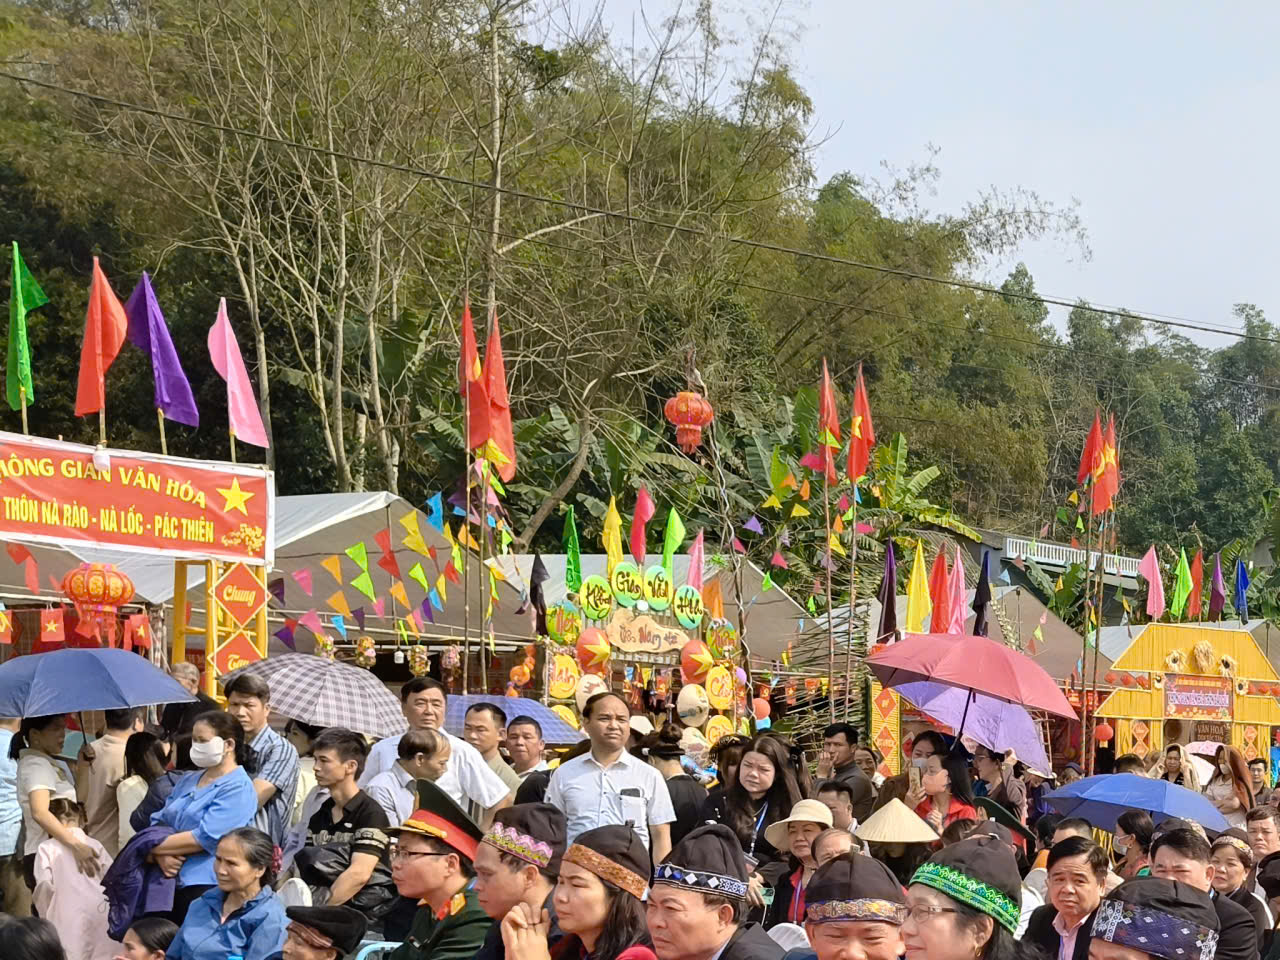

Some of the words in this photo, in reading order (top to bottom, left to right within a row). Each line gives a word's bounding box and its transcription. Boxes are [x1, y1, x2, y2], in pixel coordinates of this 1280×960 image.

[118, 466, 161, 492] VĂN
[166, 479, 206, 509] HÓA
[3, 493, 39, 523] THÔN
[42, 497, 60, 526] NÀ
[63, 500, 89, 529] RÀO
[100, 505, 118, 533] NÀ
[120, 505, 143, 535] LỐC
[154, 512, 178, 539] PÁC
[181, 516, 214, 543] THIÊN
[223, 585, 256, 607] Chung
